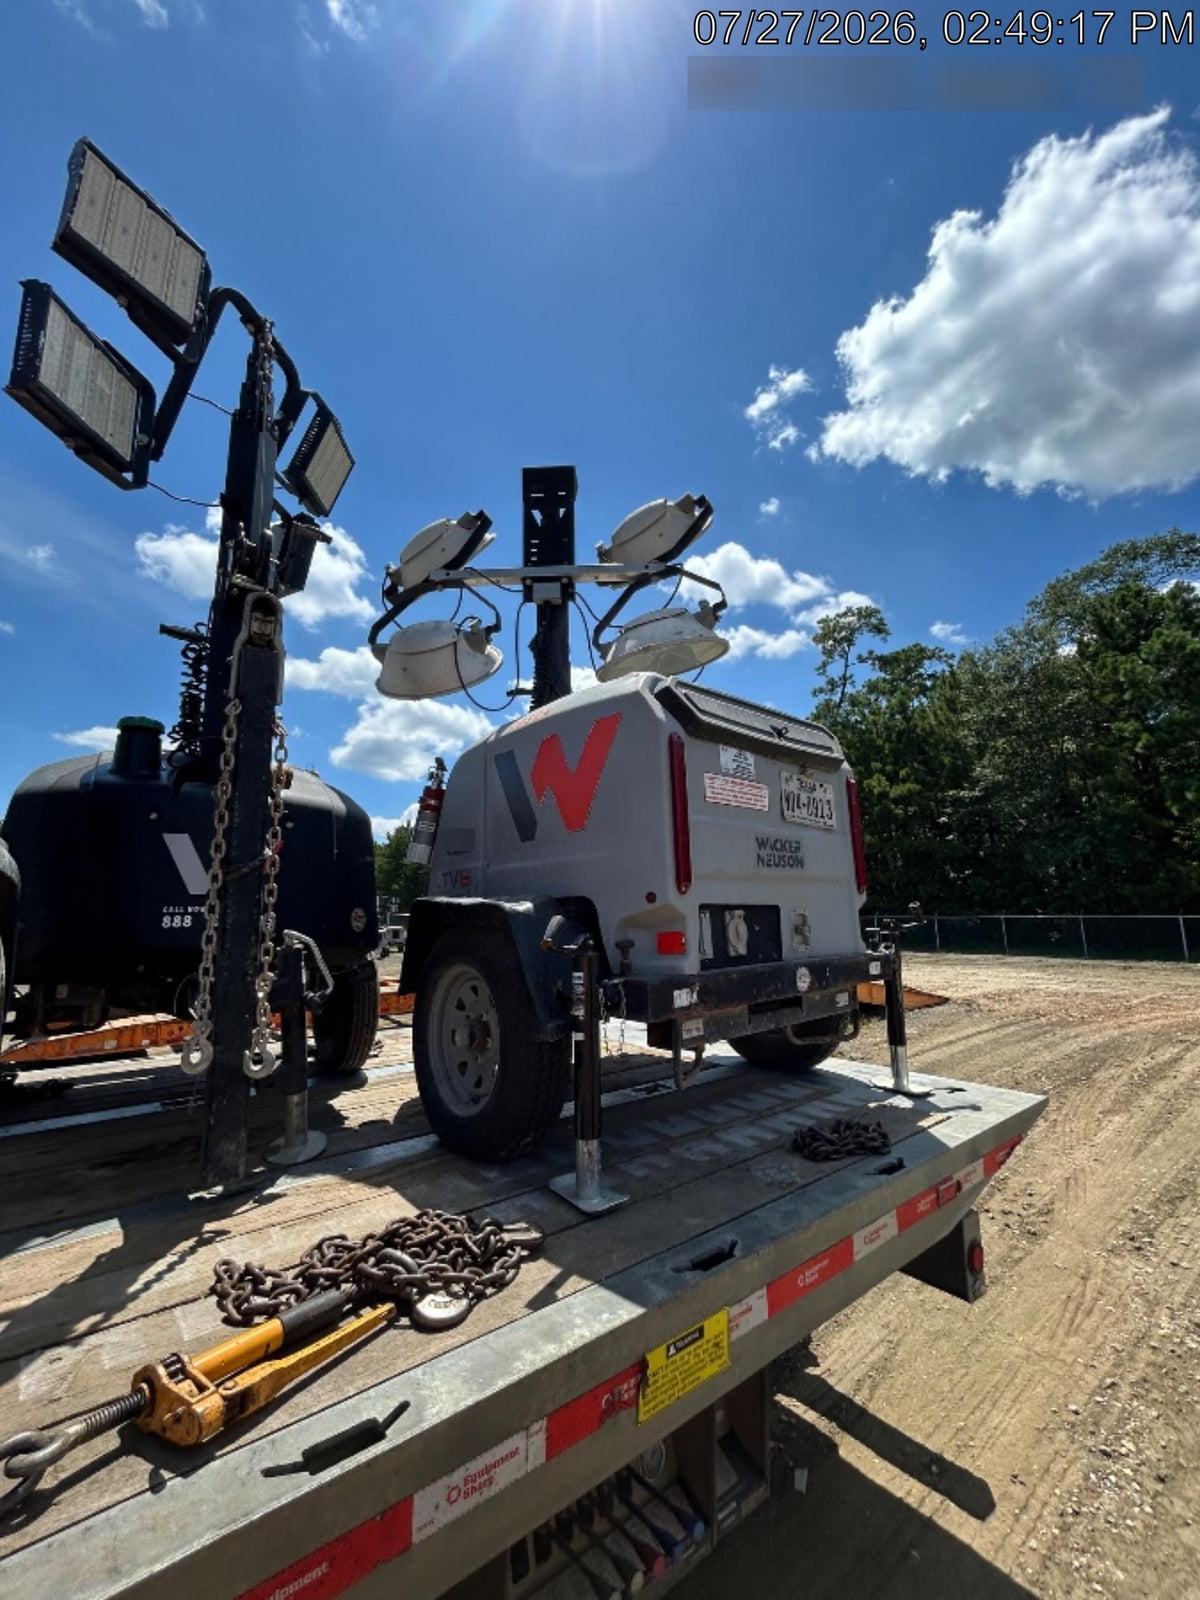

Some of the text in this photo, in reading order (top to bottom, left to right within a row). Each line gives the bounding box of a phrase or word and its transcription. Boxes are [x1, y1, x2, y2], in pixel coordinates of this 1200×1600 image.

[755, 836, 801, 854] WACKER
[756, 852, 804, 869] NEUSON
[463, 1446, 519, 1487] Equipment
